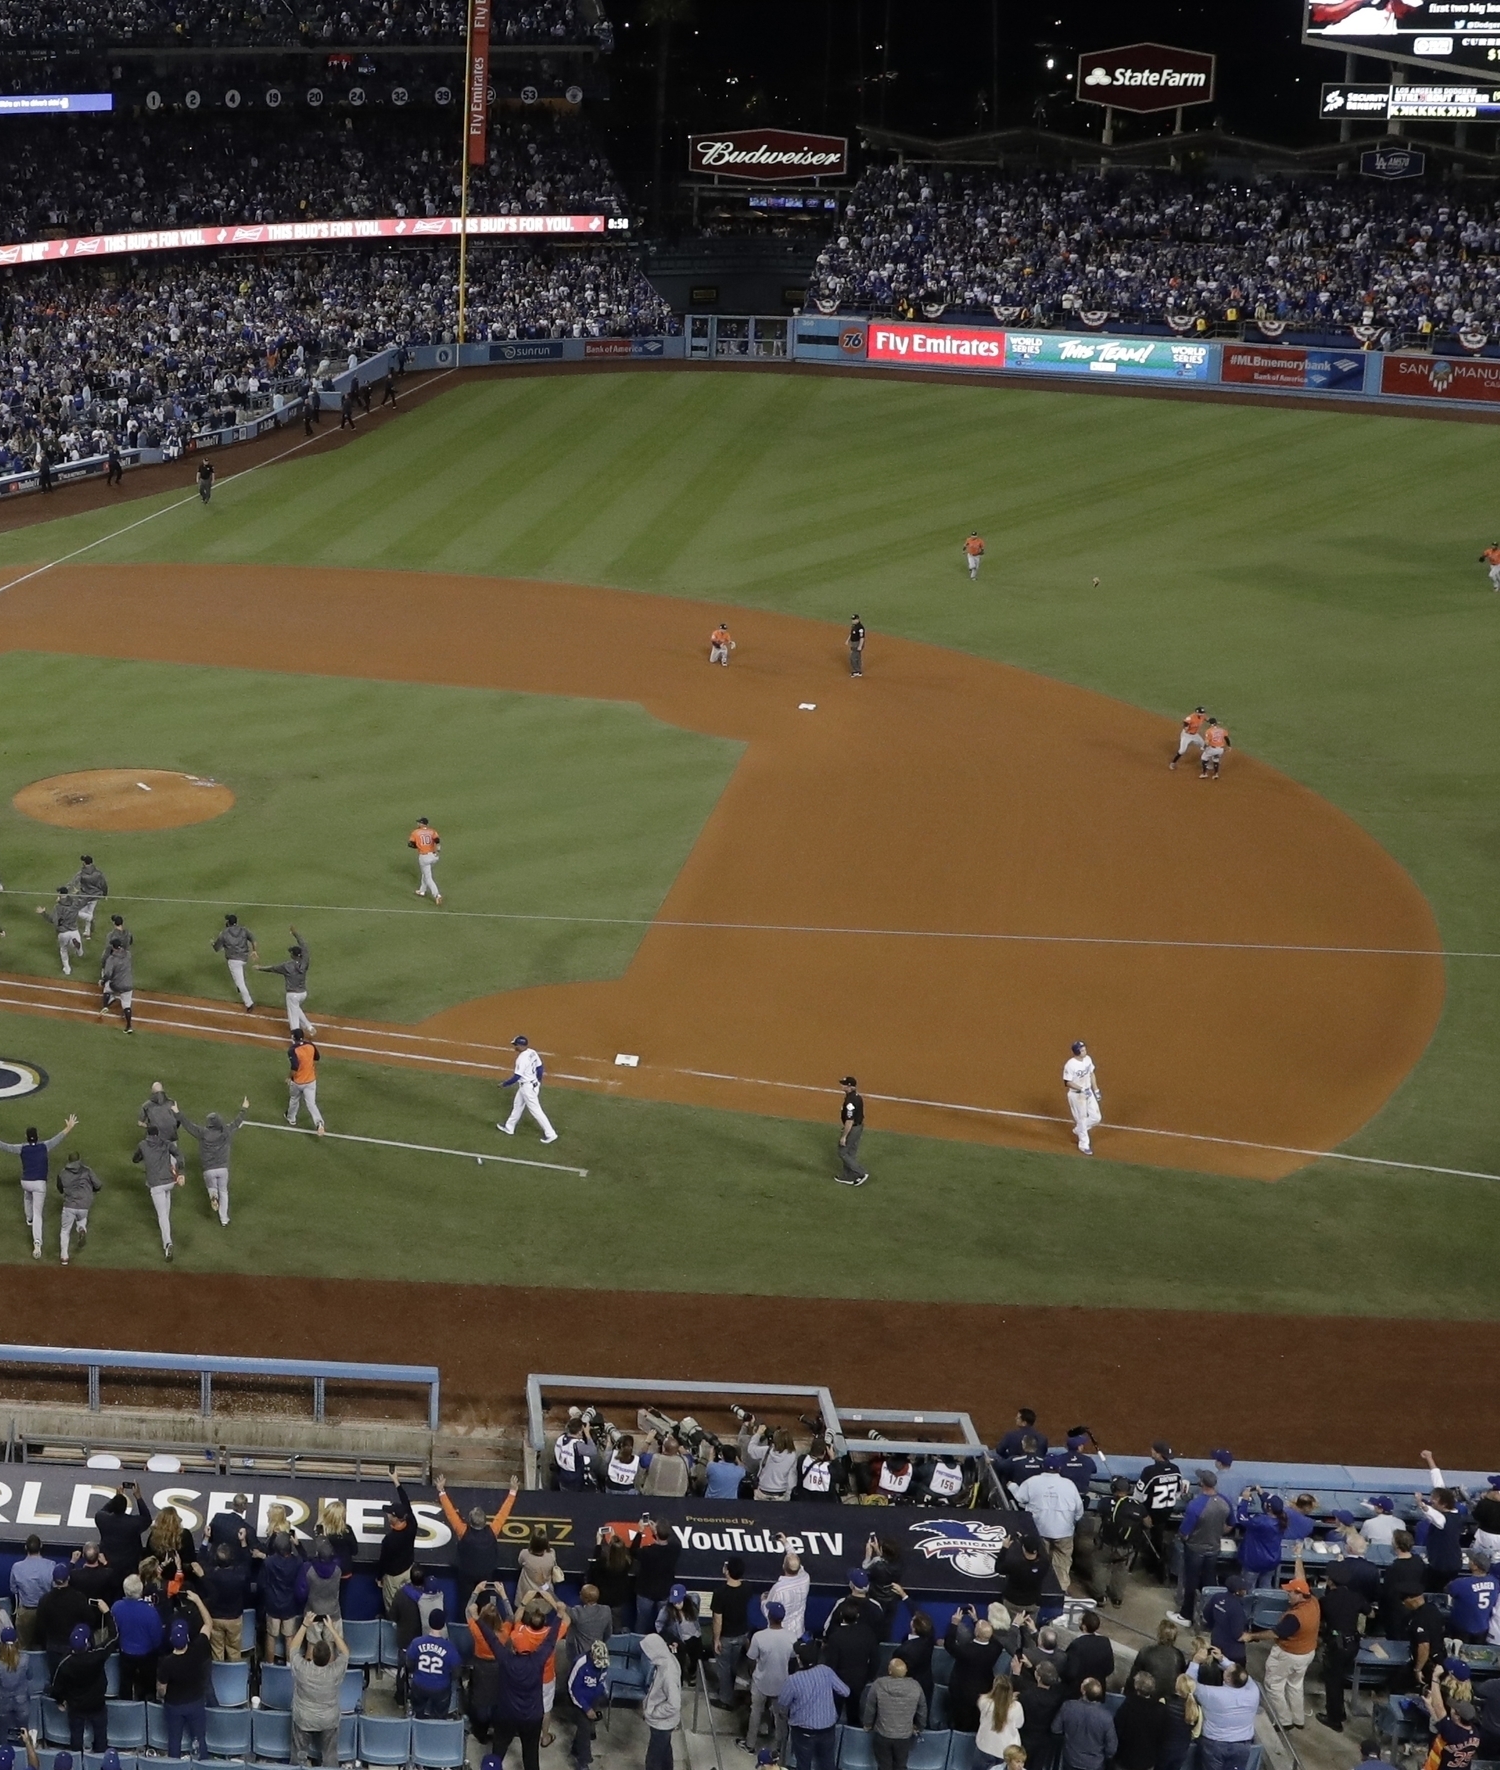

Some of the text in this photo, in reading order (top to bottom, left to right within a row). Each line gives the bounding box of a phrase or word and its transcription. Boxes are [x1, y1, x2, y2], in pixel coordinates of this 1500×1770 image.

[1429, 3, 1485, 15] first two big
[474, 7, 488, 28] Fly
[470, 57, 484, 135] Fly Emirates
[697, 141, 841, 166] Budweiser
[267, 225, 294, 240] THIS
[294, 223, 329, 239] BUD'S
[331, 222, 354, 237] FOR
[355, 221, 382, 236] YOU.
[450, 219, 480, 233] THIS
[482, 218, 517, 232] BUD'S
[519, 217, 545, 231] FOR
[547, 217, 574, 231] YOU.
[104, 237, 126, 252] THIS
[127, 234, 158, 250] BUD'S
[159, 231, 180, 248] FOR
[181, 230, 204, 246] YOU.
[843, 333, 863, 348] 76
[876, 332, 999, 357] Fly Emirates
[1010, 337, 1043, 346] WORLD
[516, 346, 550, 357] sunrun
[586, 345, 604, 354] Bank
[613, 345, 642, 353] America
[1012, 345, 1040, 354] SERIES
[1058, 340, 1155, 364] THIS TEAM!
[1171, 346, 1206, 357] WORLD
[1173, 355, 1204, 365] SERIES
[1230, 355, 1331, 371] #MLBmemorybank
[1400, 362, 1428, 375] SAN
[1254, 373, 1270, 381] Bank
[1278, 374, 1308, 384] America
[421, 835, 431, 845] 10
[616, 1473, 630, 1483] 187
[1151, 1482, 1178, 1509] 23
[151, 1487, 453, 1549] SERES
[686, 1515, 755, 1527] Presented By
[936, 1540, 996, 1549] AMERICAN
[1472, 1581, 1495, 1592] SEAGER
[1477, 1592, 1491, 1610] 5
[418, 1655, 444, 1674] 22
